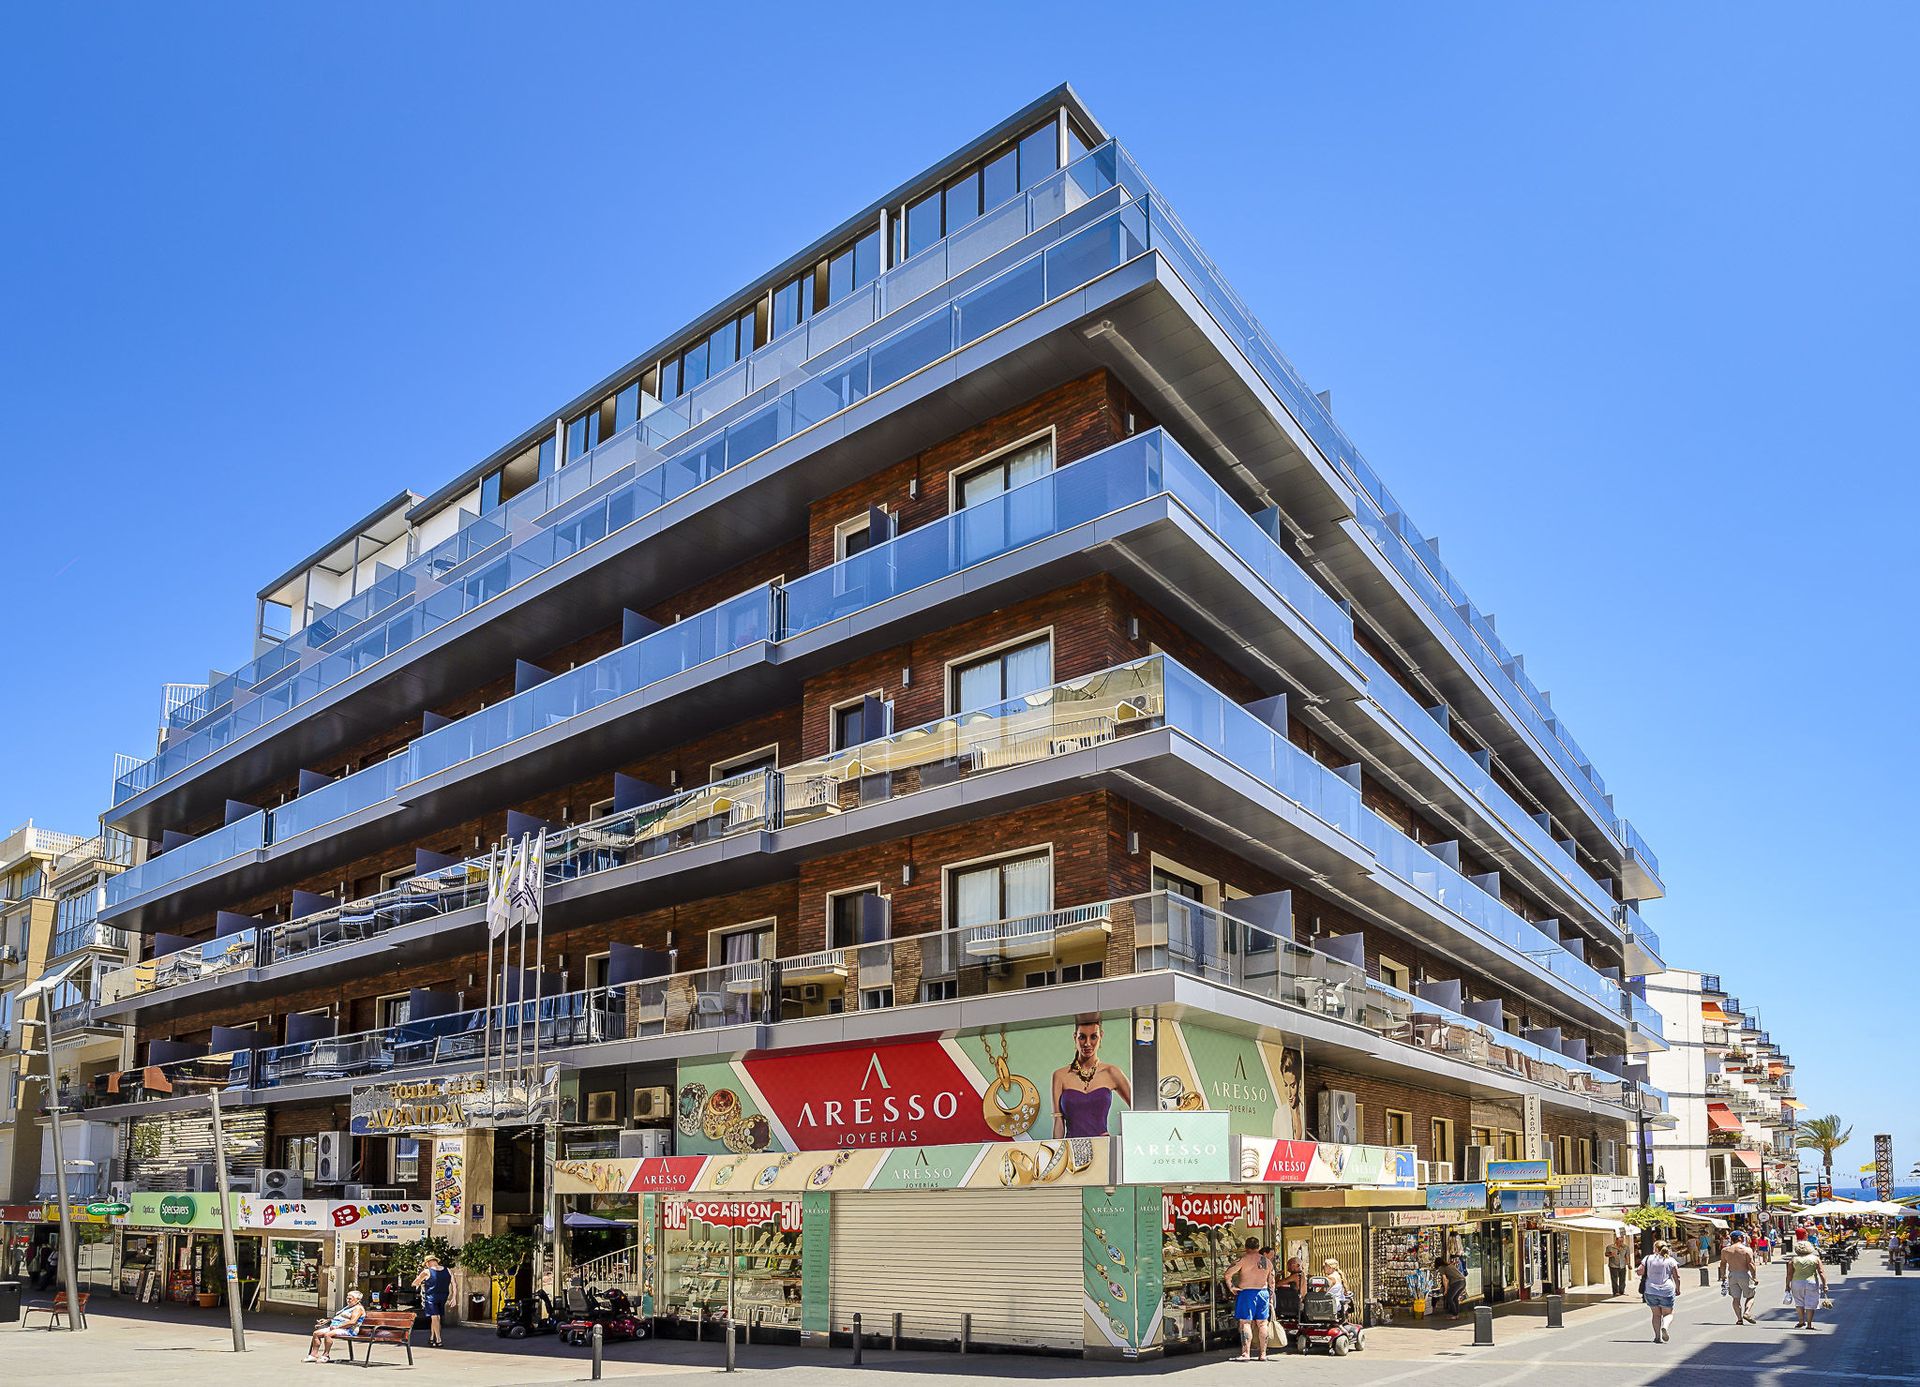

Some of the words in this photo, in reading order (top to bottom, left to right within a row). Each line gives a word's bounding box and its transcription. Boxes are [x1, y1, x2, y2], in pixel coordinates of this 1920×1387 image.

[389, 1083, 441, 1100] HOTEL
[1211, 1081, 1267, 1102] ARESSO
[366, 1103, 466, 1128] AVENIDA
[797, 1091, 958, 1128] ARESSO
[1226, 1104, 1256, 1115] JOYERÍAS
[837, 1129, 918, 1145] JOYERÍAS
[1133, 1144, 1217, 1156] ARESSO
[1153, 1157, 1199, 1165] JOYERÍAS
[1271, 1160, 1306, 1172] ARESSO
[643, 1174, 686, 1185] ARESSO
[891, 1167, 952, 1180] ARESSO
[91, 1205, 126, 1215] Specsavers
[161, 1203, 189, 1216] Specsavers
[696, 1202, 771, 1218] OCASIÓN
[1162, 1195, 1175, 1231] 0%
[1181, 1195, 1241, 1215] OCASIÓN
[1247, 1195, 1264, 1227] 50%
[402, 1219, 425, 1227] zapatos
[781, 1201, 803, 1230] 50
